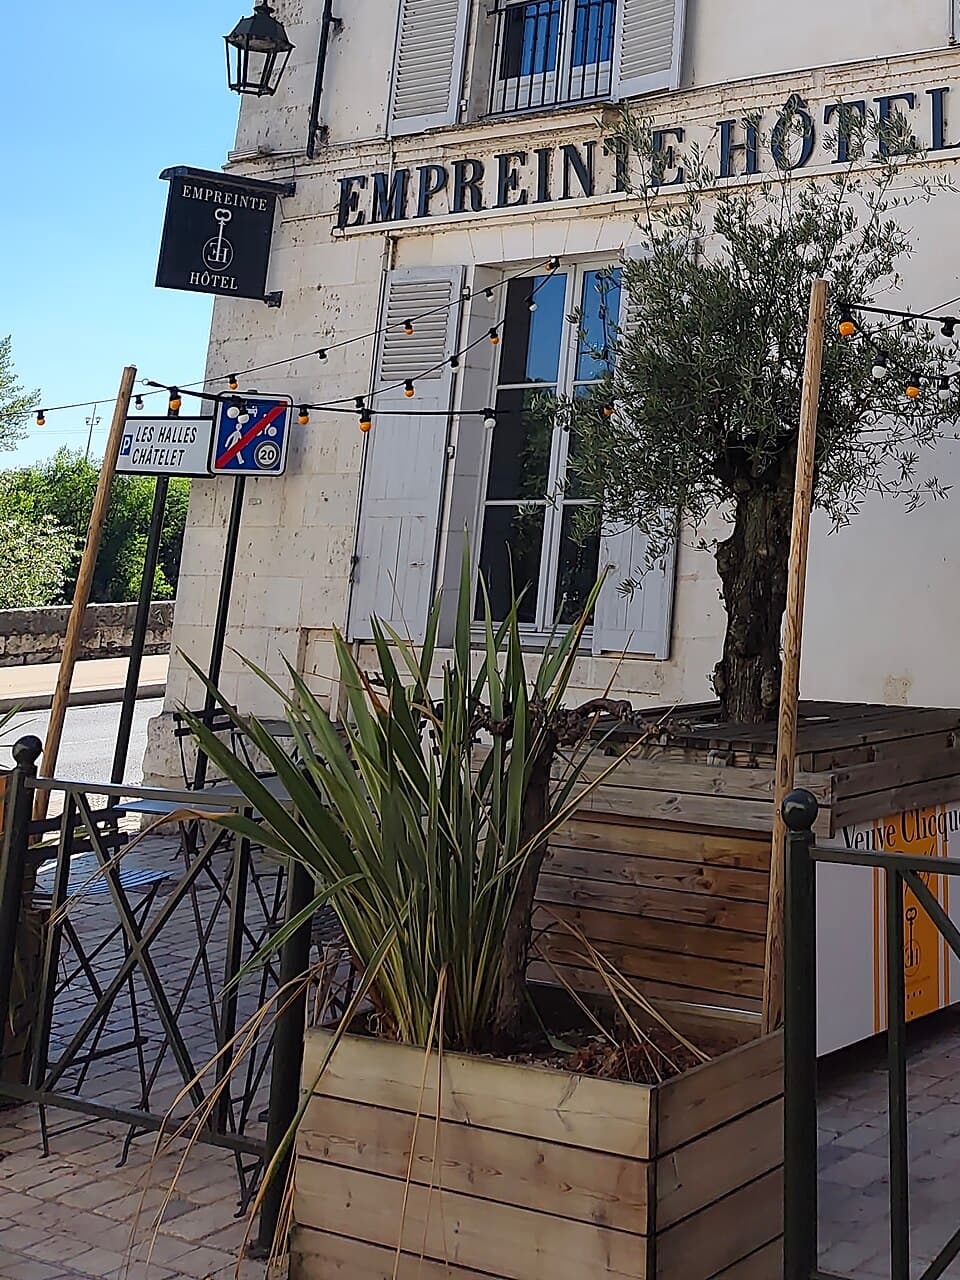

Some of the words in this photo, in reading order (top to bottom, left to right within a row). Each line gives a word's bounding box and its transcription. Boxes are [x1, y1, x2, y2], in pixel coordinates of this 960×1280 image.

[332, 126, 686, 228] EMPREINTE
[182, 185, 268, 211] EMPREINTE
[189, 271, 238, 290] HÔTEL
[121, 438, 131, 451] P
[135, 426, 155, 443] LES
[157, 426, 198, 444] HALLES
[131, 445, 185, 467] CHÂTELET
[260, 449, 275, 461] 20
[842, 824, 896, 851] Veuve
